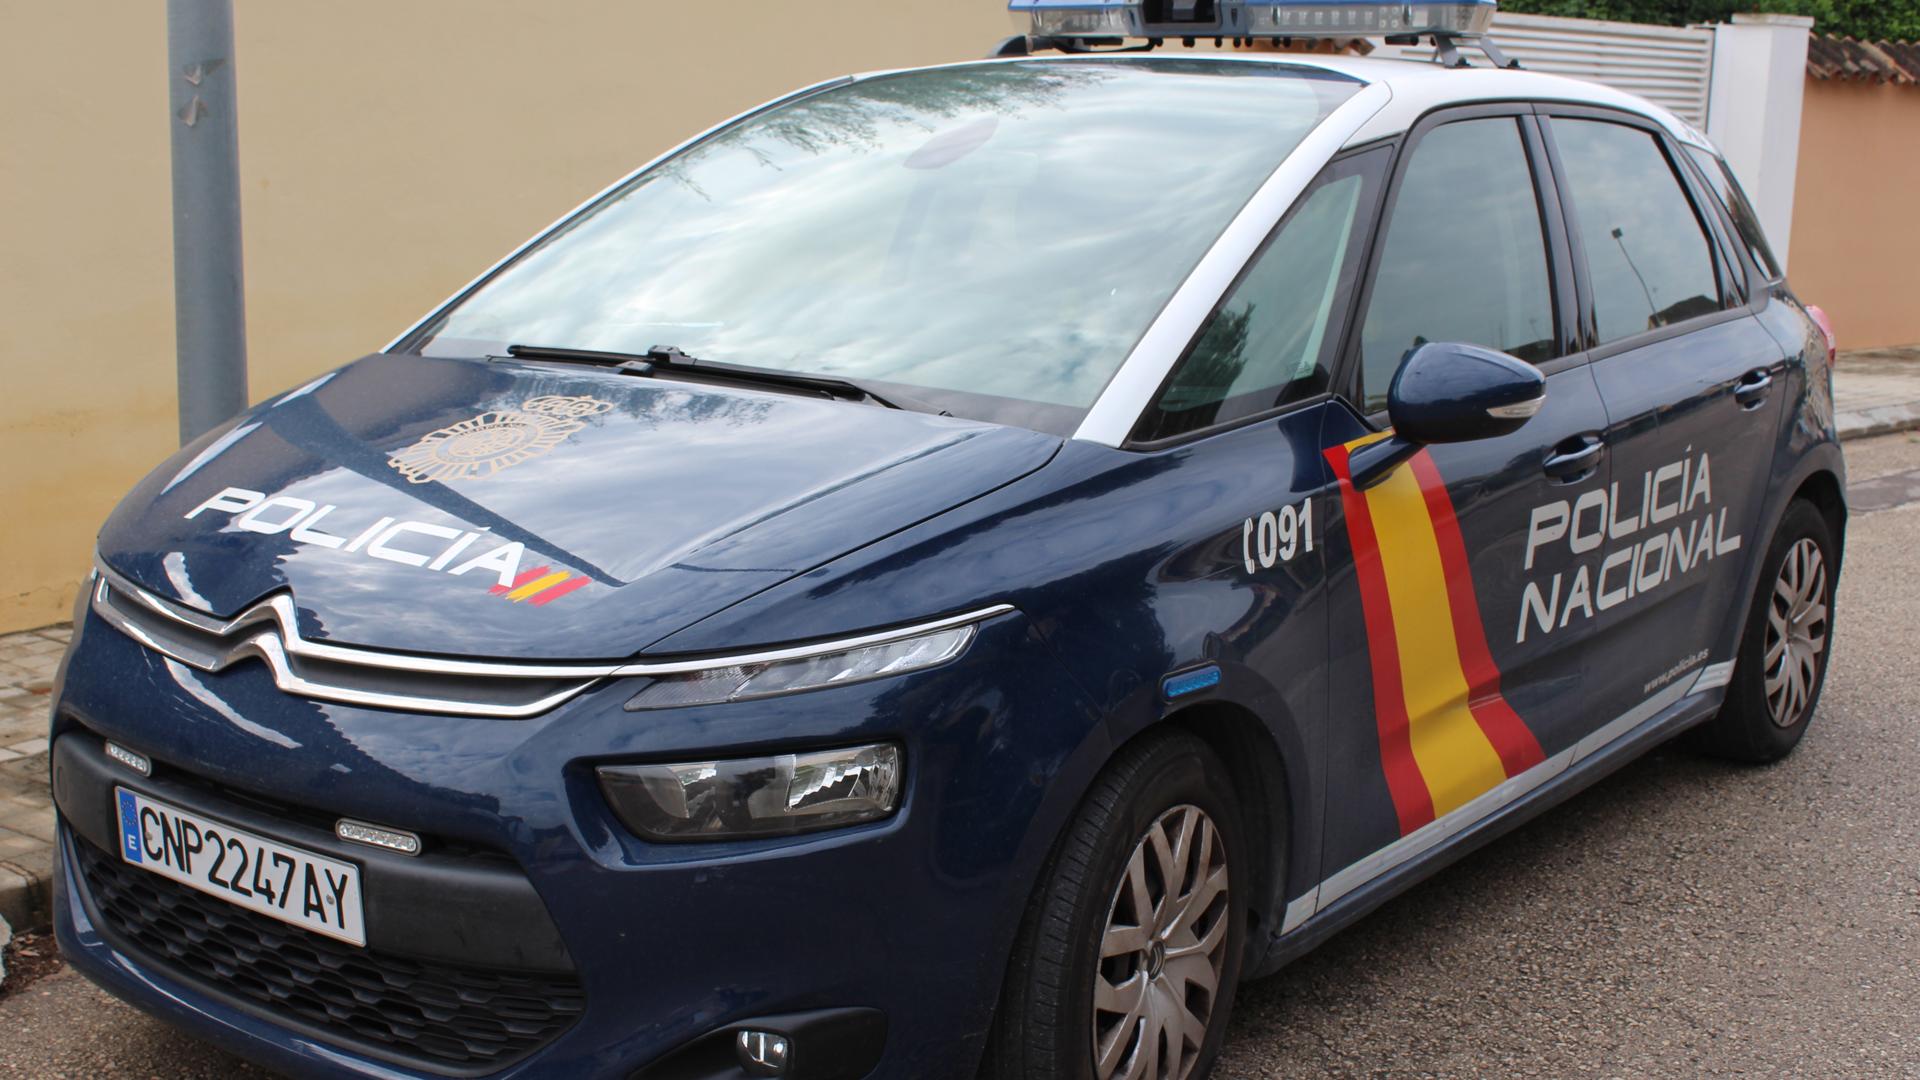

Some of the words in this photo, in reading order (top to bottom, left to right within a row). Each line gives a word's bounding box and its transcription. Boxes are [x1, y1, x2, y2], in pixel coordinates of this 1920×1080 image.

[184, 487, 525, 588] POLICÍA
[1257, 497, 1313, 569] 091
[1524, 444, 1711, 570] POLICÍA
[1517, 506, 1741, 643] NACIONAL
[128, 835, 138, 850] E
